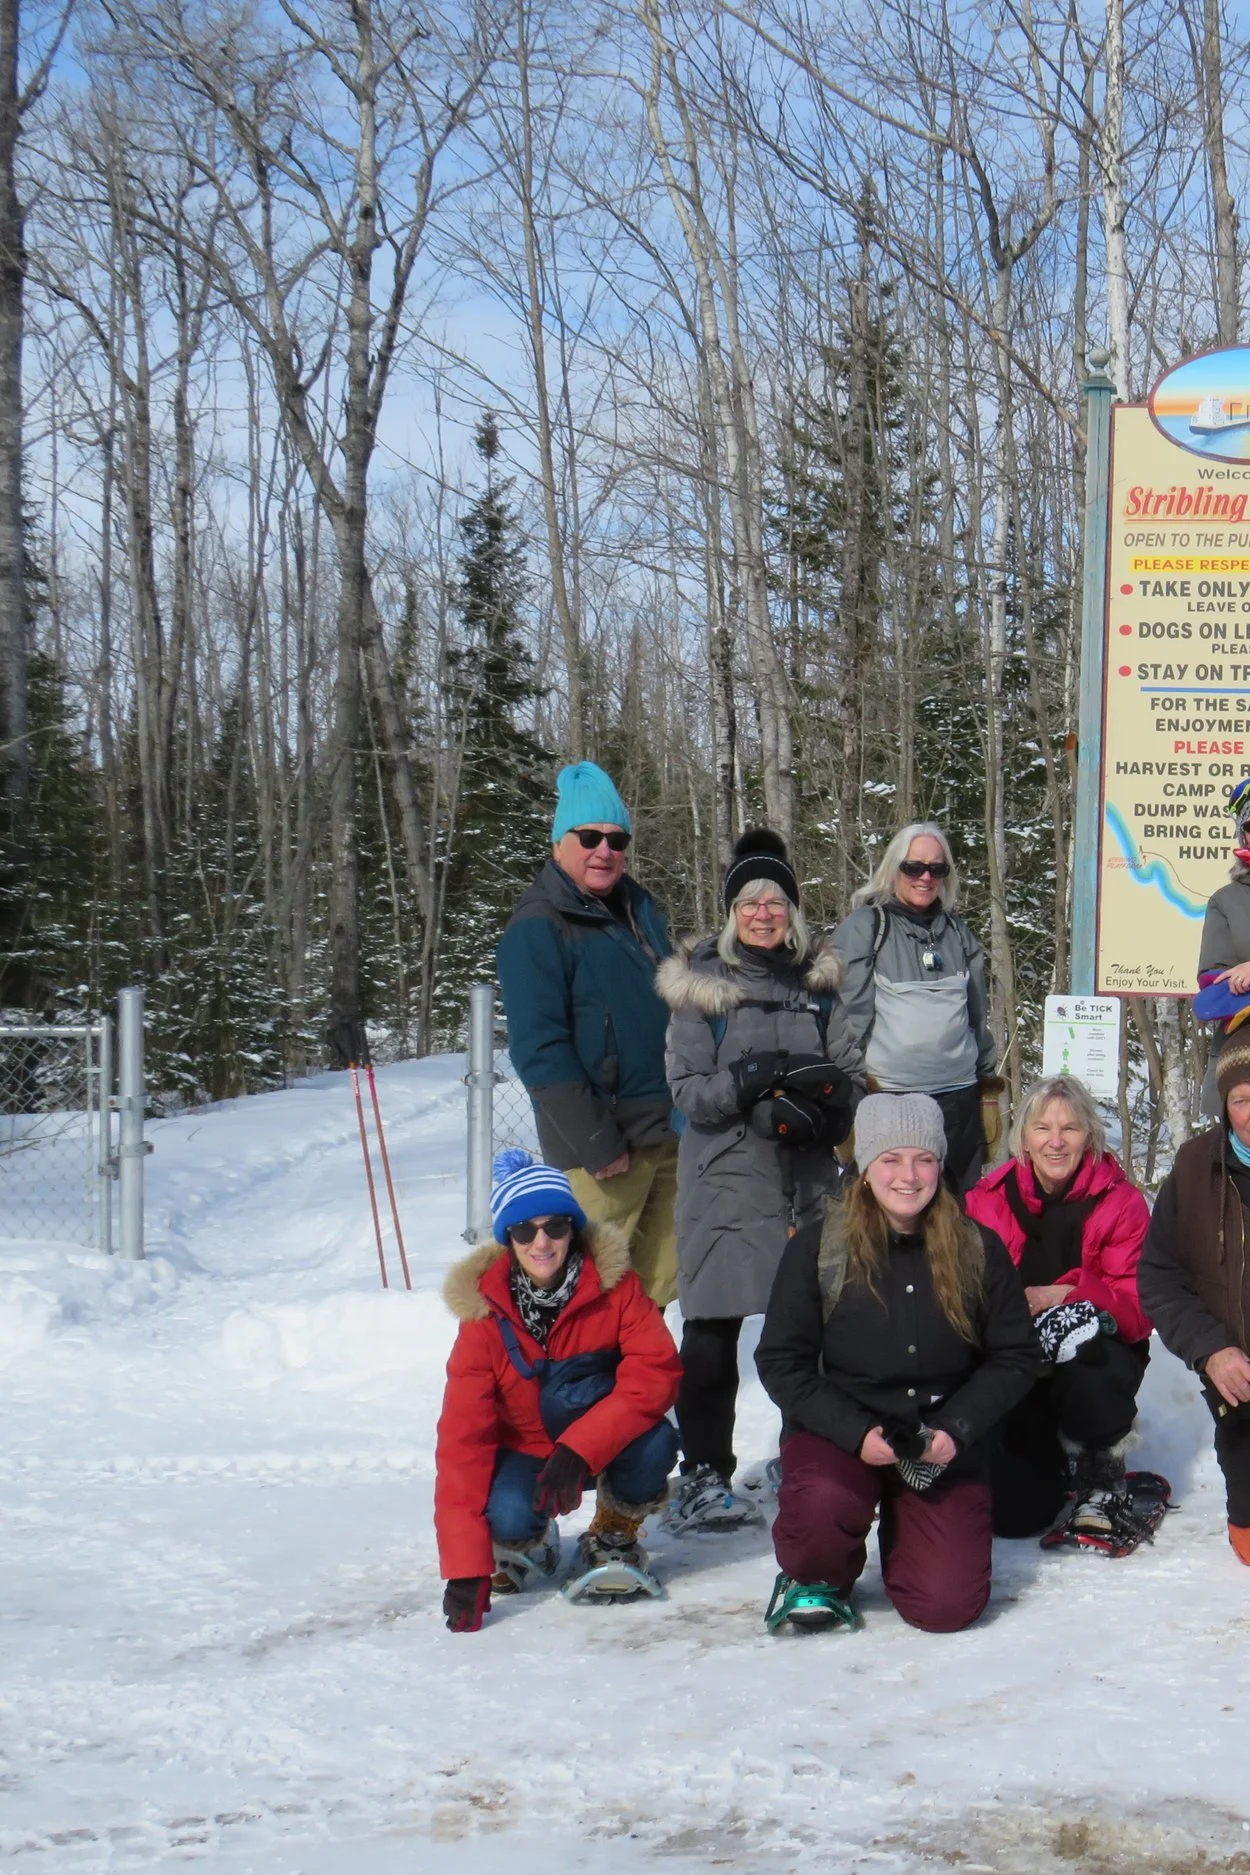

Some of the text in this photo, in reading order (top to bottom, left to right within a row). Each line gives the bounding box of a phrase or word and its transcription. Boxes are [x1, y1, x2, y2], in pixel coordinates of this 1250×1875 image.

[1126, 486, 1248, 523] Stribling
[1124, 533, 1167, 547] OPEN
[1171, 533, 1190, 547] TO
[1195, 533, 1223, 547] THE
[1134, 559, 1194, 570] PLEASE
[1139, 581, 1191, 597] TAKE
[1197, 581, 1250, 598] ONLY
[1187, 602, 1236, 613] LEAVE
[1138, 622, 1192, 639] DOGS
[1199, 623, 1227, 639] ON
[1137, 664, 1189, 681] STAY
[1195, 664, 1223, 681] ON
[1150, 698, 1187, 711] FOR
[1193, 698, 1229, 712] THE
[1174, 741, 1244, 755] PLEASE
[1116, 762, 1201, 776] HARVEST
[1208, 763, 1234, 777] OR
[1163, 783, 1217, 797] CAMP
[1134, 804, 1187, 818] DUMP
[1143, 825, 1201, 839] BRING
[1179, 846, 1231, 860] HUNT
[1111, 963, 1141, 976] Thank
[1145, 965, 1165, 976] You
[1105, 976, 1188, 989] Enjoy Your Visit.
